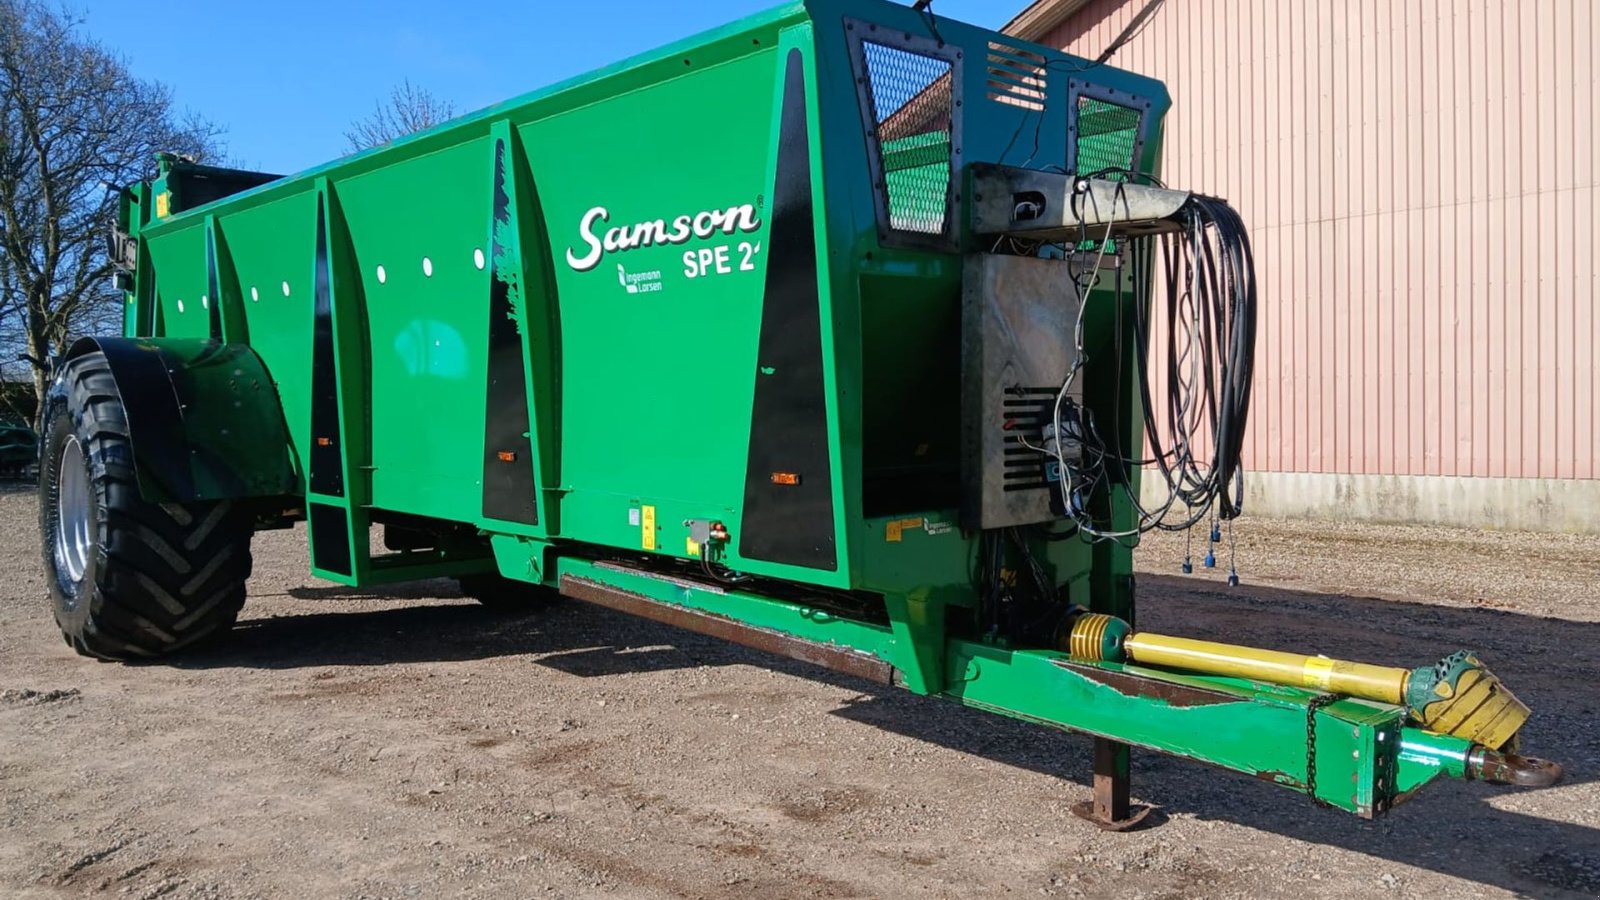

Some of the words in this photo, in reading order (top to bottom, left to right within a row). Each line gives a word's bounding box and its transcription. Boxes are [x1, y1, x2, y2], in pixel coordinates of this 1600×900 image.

[566, 204, 761, 271] Samson
[683, 245, 732, 278] SPE
[738, 240, 761, 271] 2
